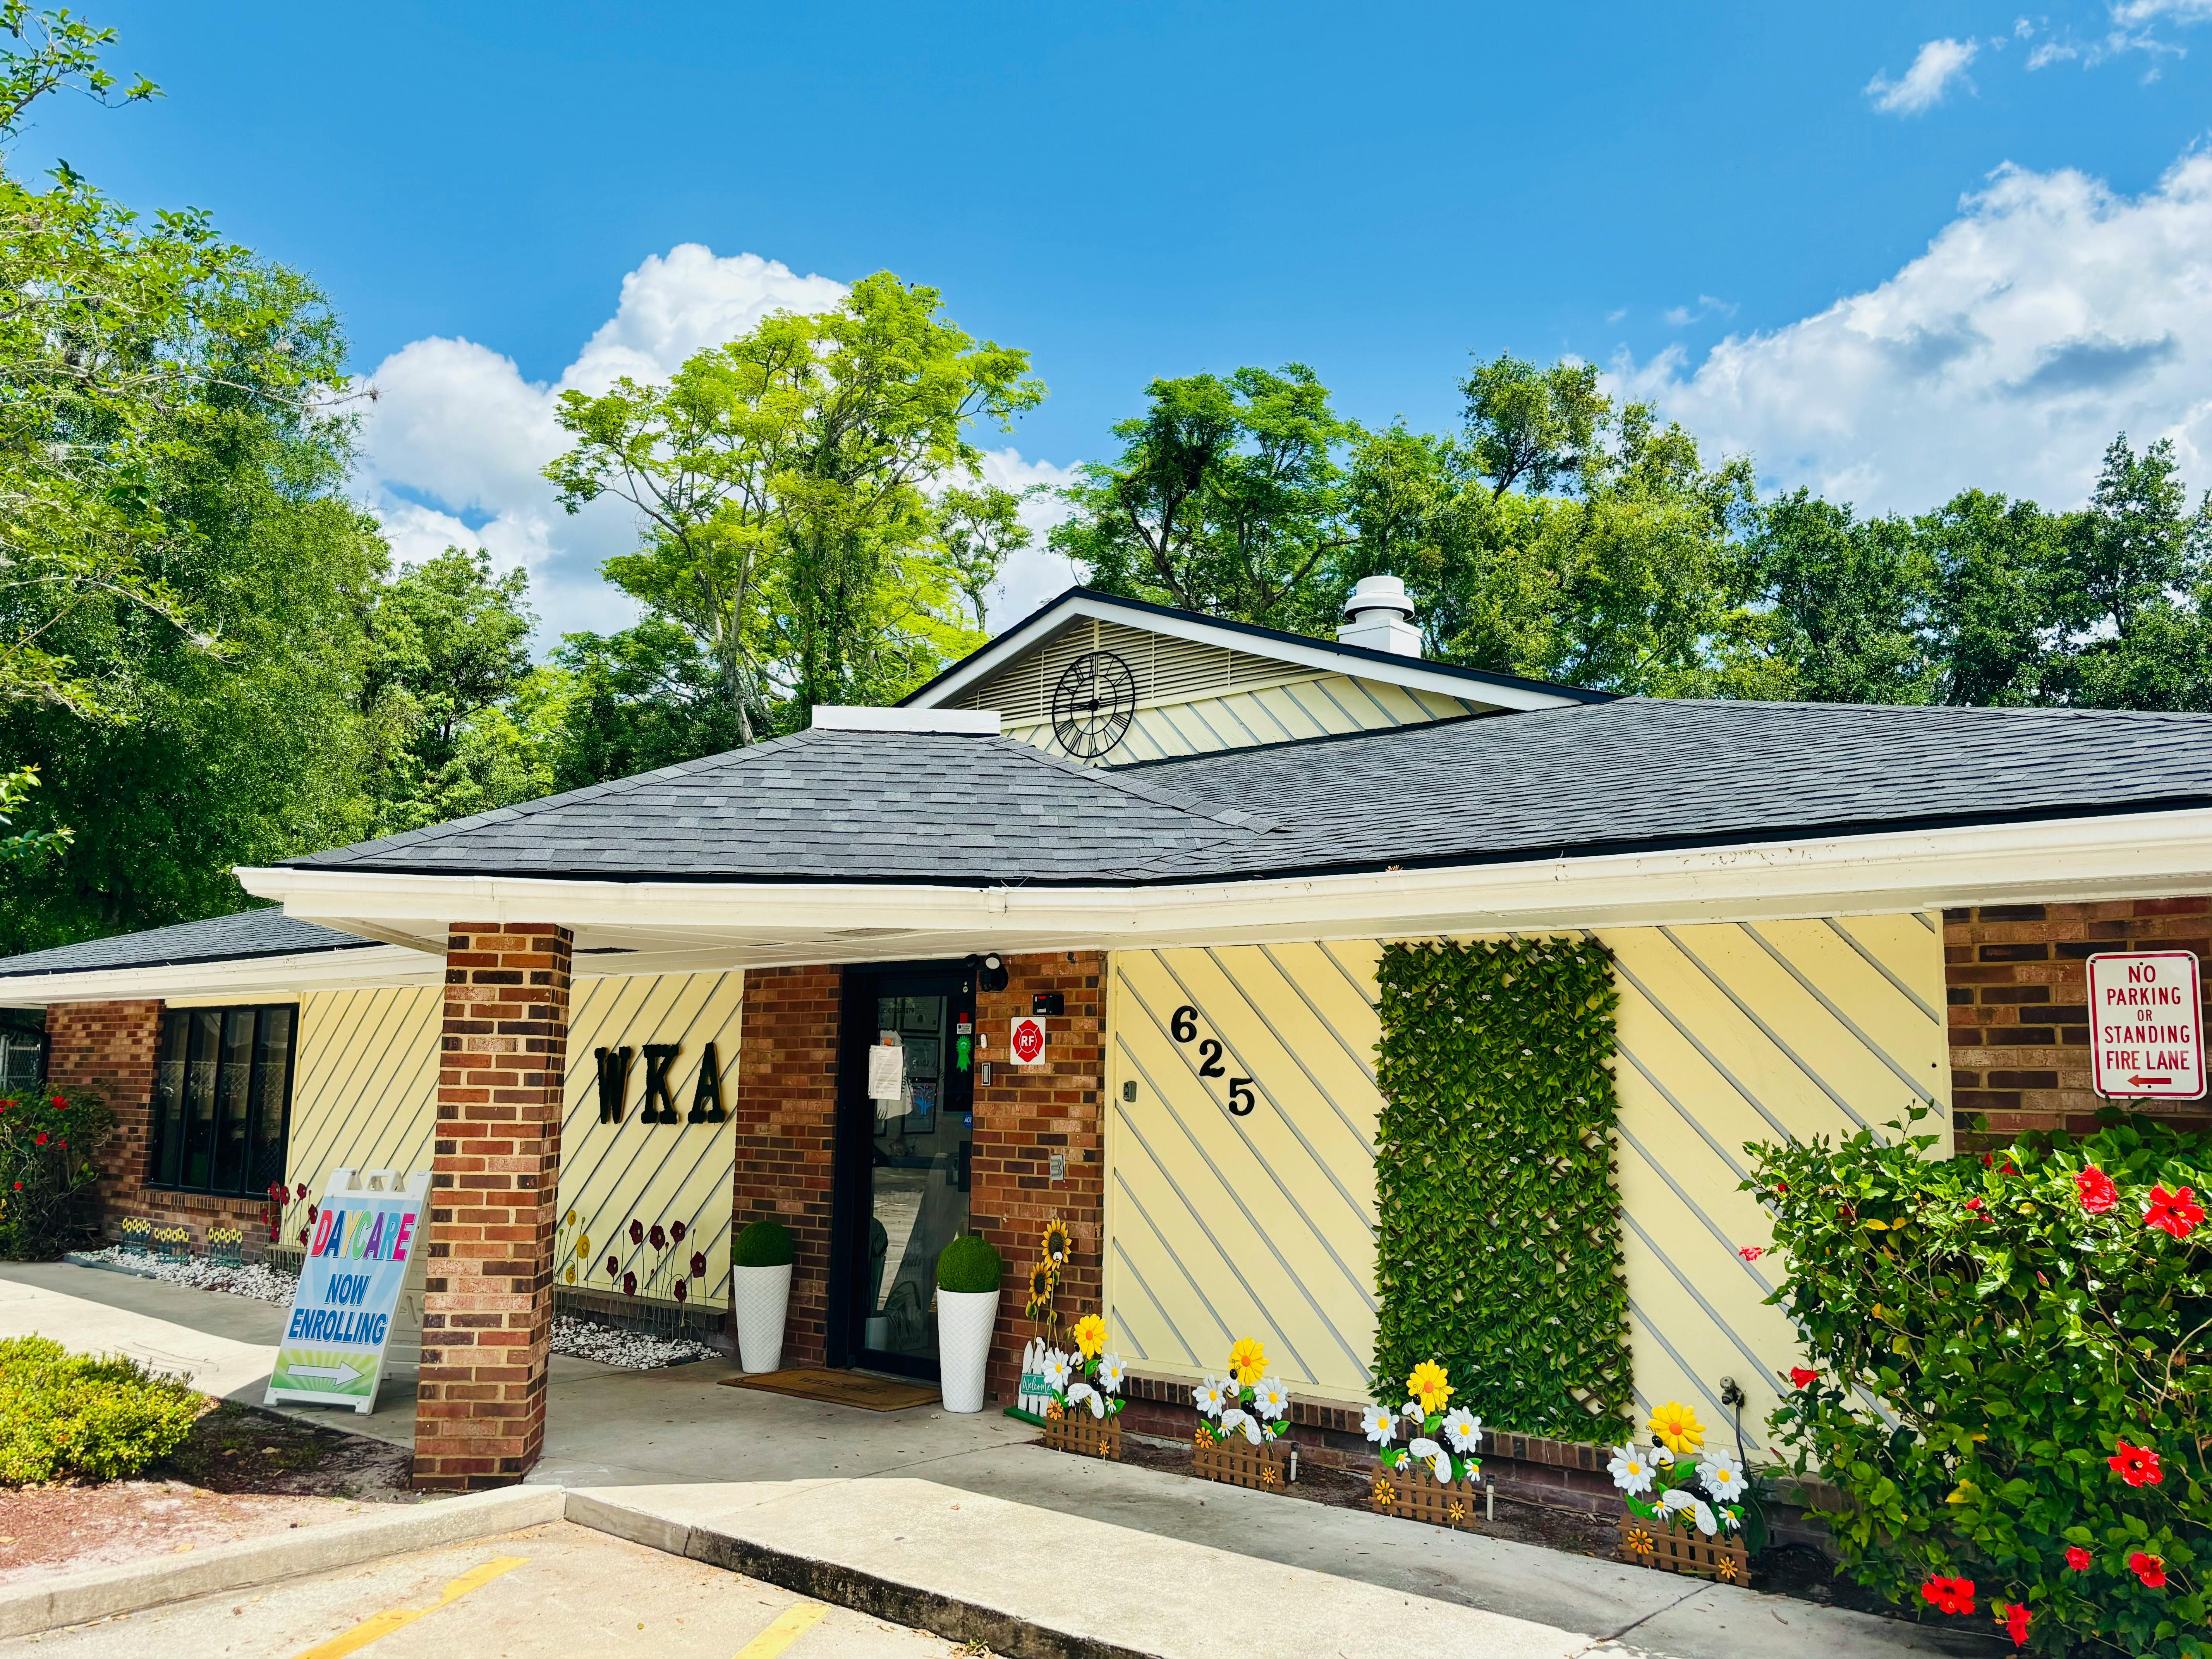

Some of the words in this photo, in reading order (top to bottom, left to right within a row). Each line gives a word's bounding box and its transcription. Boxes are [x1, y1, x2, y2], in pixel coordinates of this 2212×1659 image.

[2128, 965, 2156, 983] NO
[2107, 987, 2181, 1005] PARKING
[2137, 1010, 2152, 1021] OR
[1021, 1035, 1035, 1047] RF
[2105, 1025, 2190, 1043] STANDING
[1171, 1005, 1255, 1116] 625
[2107, 1051, 2140, 1070] FIRE
[2147, 1051, 2190, 1070] LANE
[594, 1042, 726, 1125] WKA
[311, 1209, 417, 1261] DAYCARE
[324, 1273, 371, 1306] NOW
[287, 1308, 388, 1345] ENROLLING
